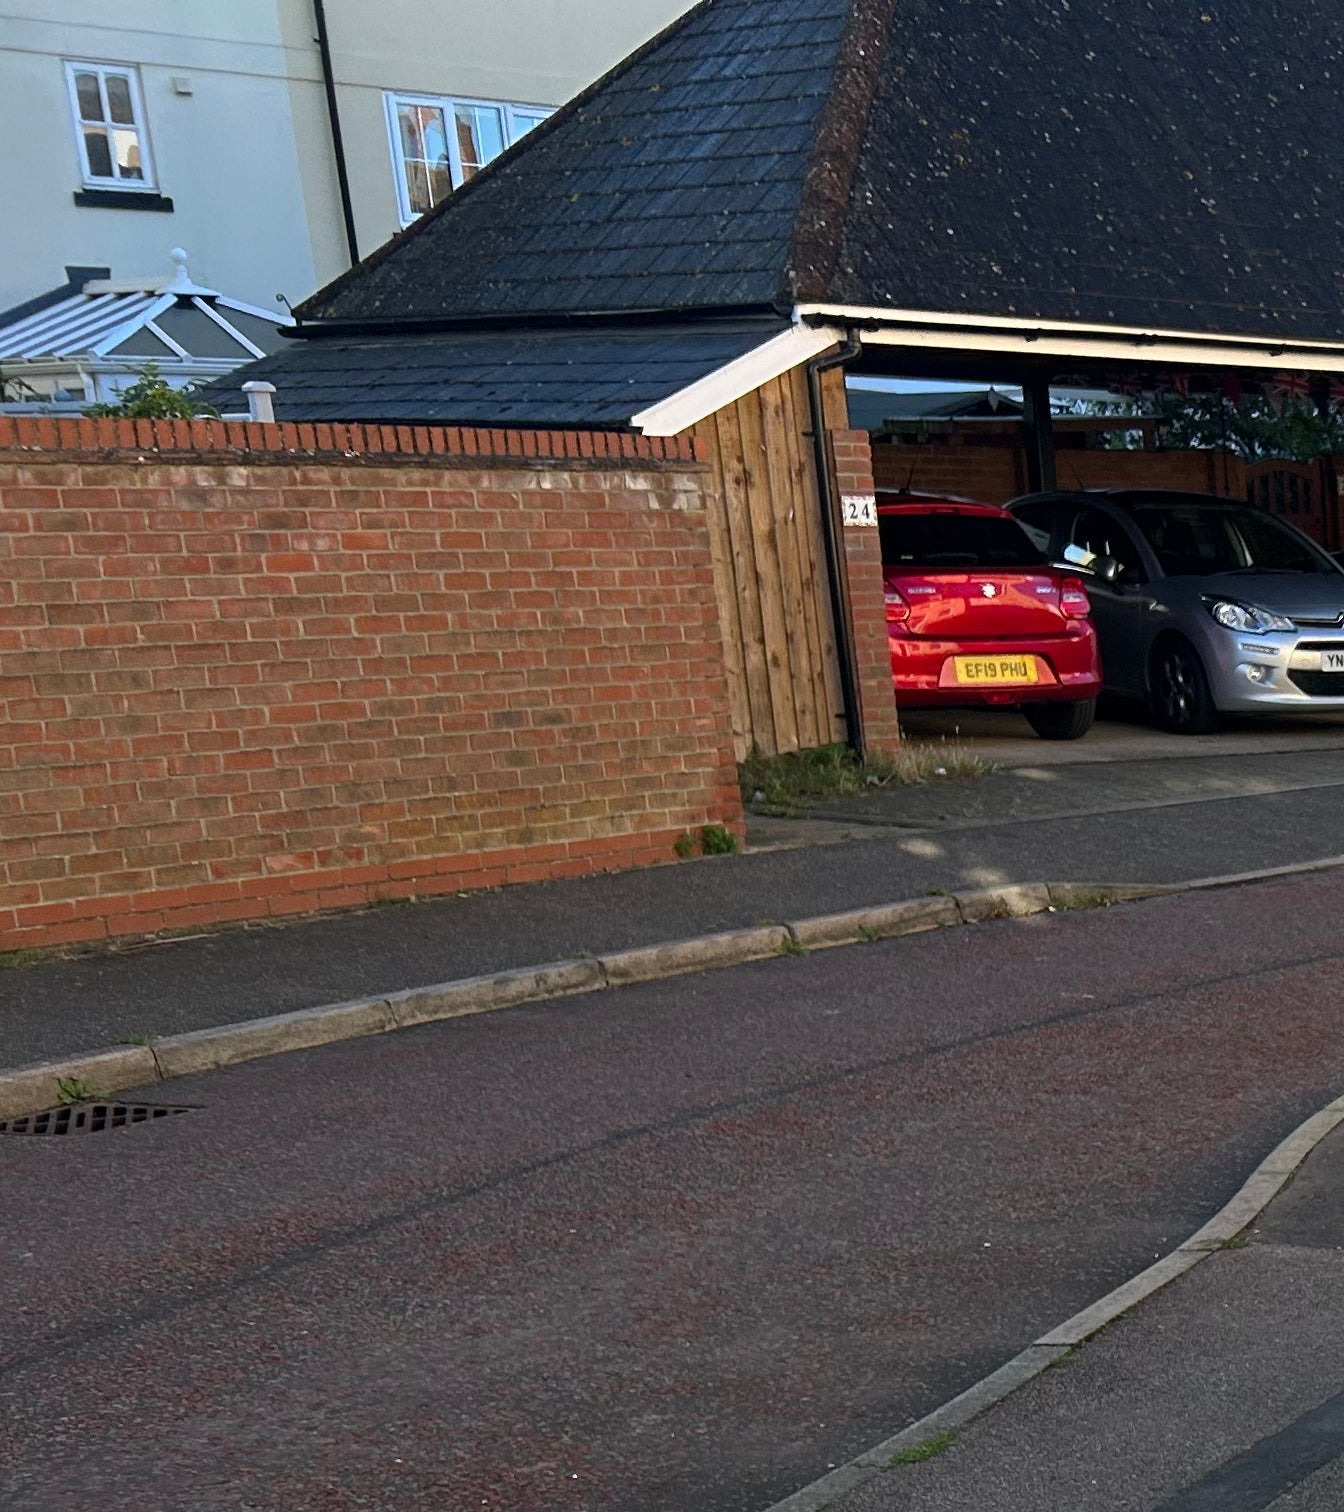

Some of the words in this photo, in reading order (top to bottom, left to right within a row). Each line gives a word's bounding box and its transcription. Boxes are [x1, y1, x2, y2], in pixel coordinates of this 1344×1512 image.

[849, 502, 870, 519] 24
[965, 663, 997, 678] EF19
[1000, 661, 1028, 677] PHU
